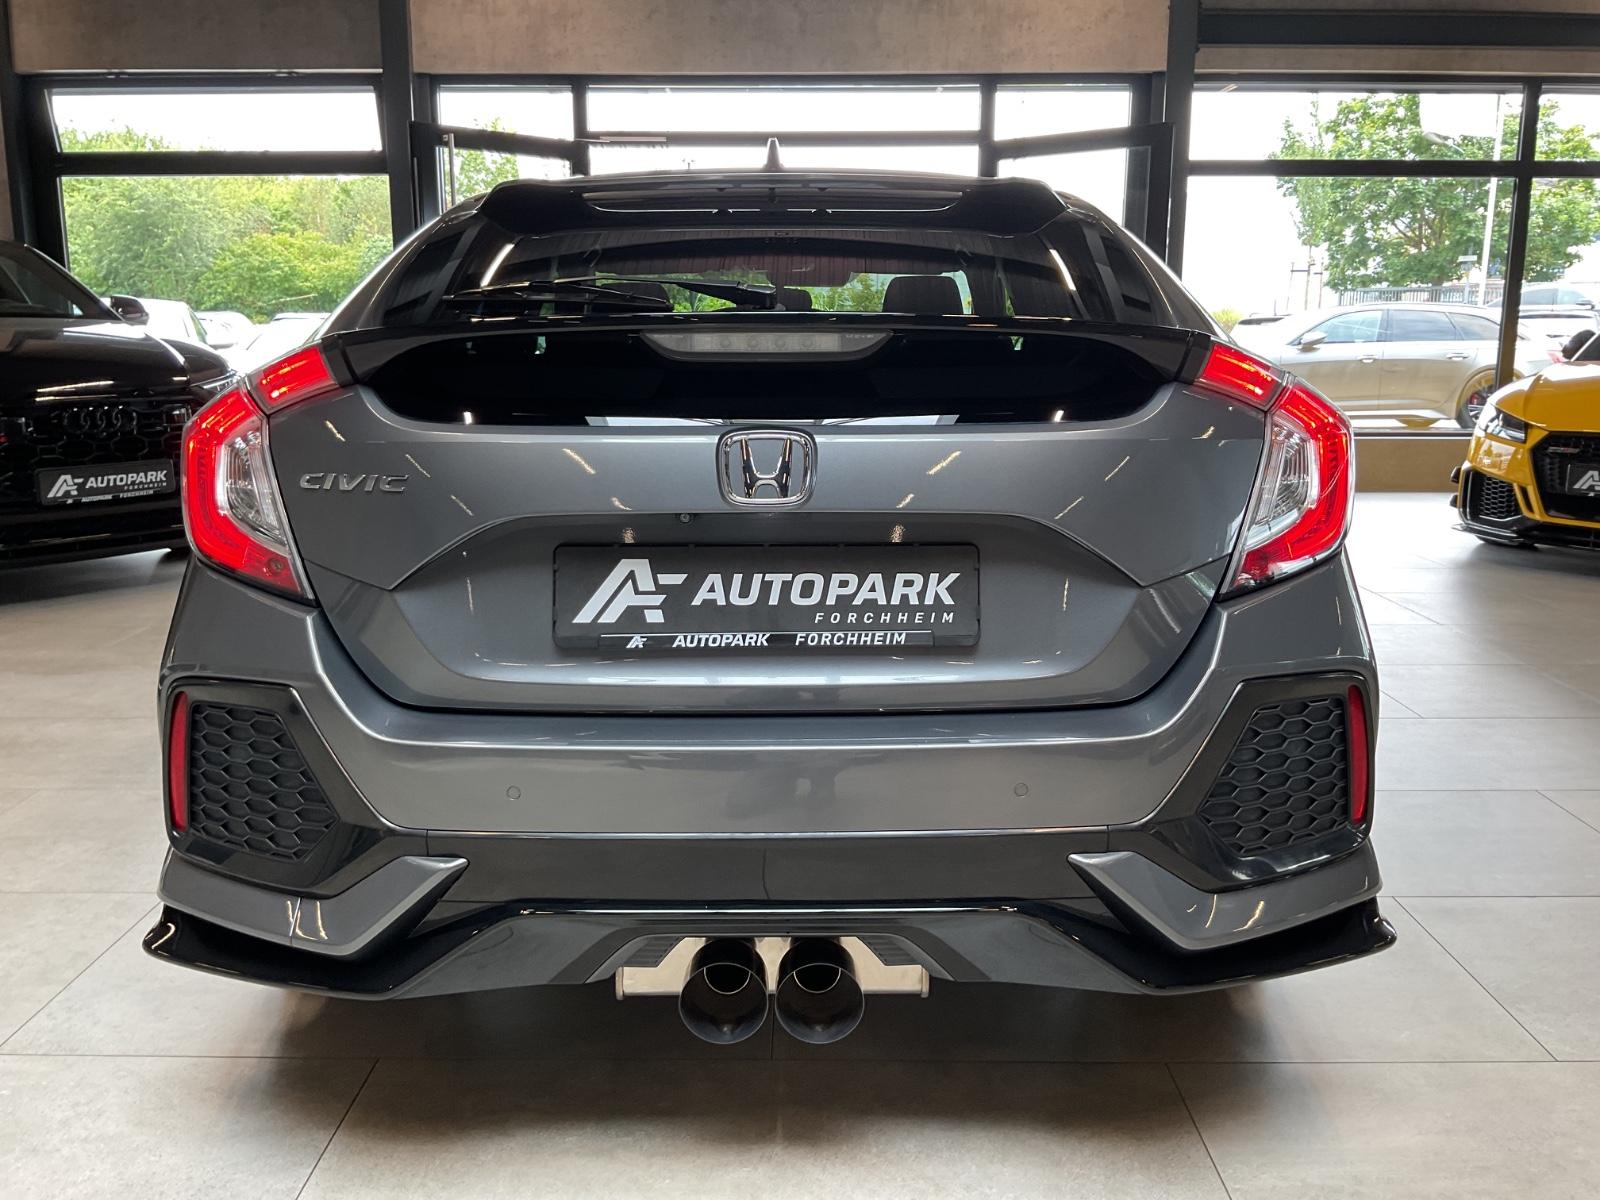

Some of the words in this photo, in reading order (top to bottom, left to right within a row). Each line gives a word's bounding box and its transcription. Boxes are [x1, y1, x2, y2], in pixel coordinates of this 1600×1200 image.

[85, 470, 167, 489] AUTOPARK
[299, 473, 409, 492] CIVIC
[690, 572, 960, 606] AUTOPARK
[814, 612, 954, 624] FORCHHEIM
[672, 633, 770, 648] AUTOPARK
[795, 631, 907, 646] FORCHHEIM
